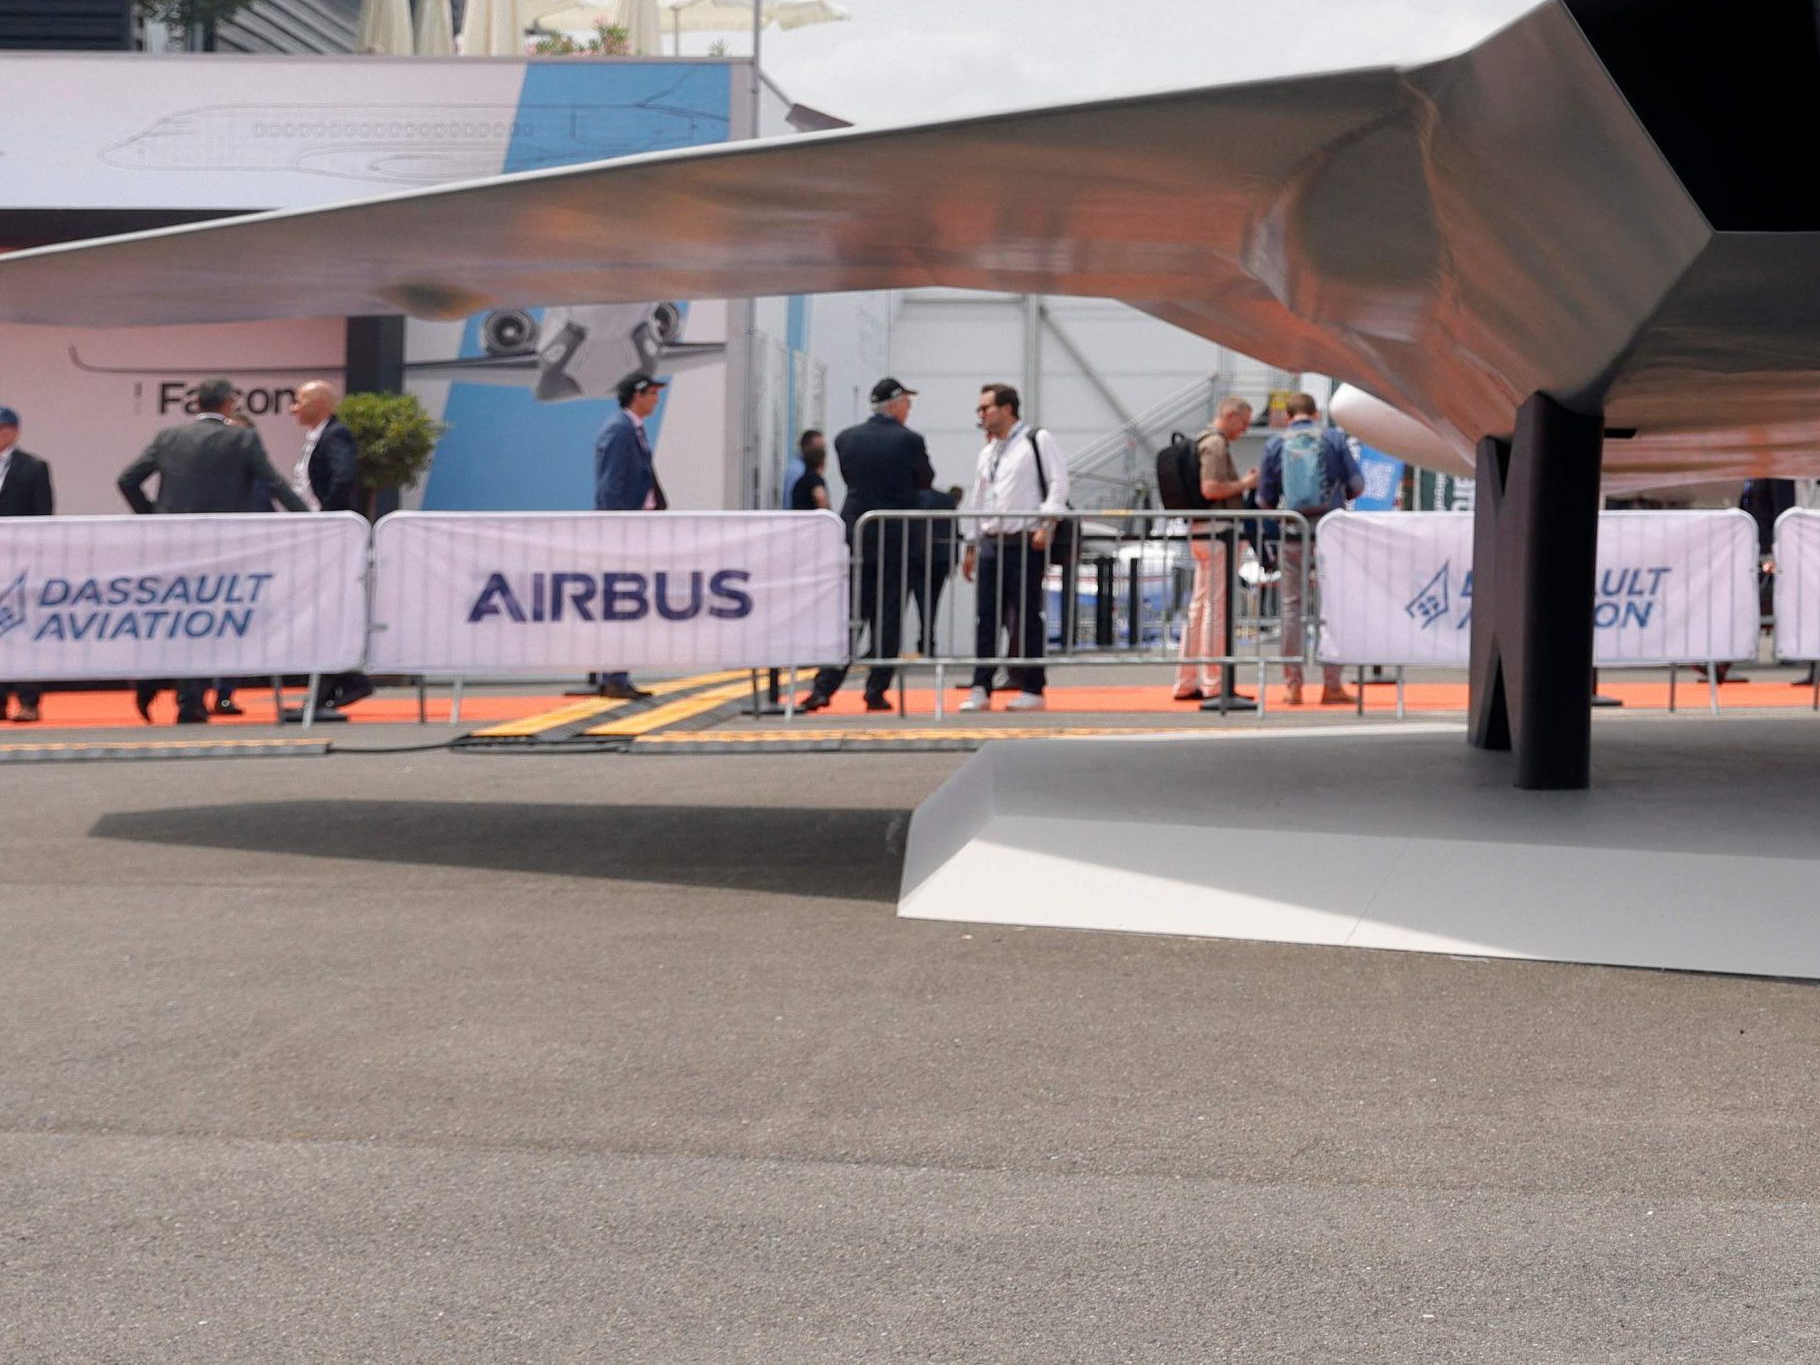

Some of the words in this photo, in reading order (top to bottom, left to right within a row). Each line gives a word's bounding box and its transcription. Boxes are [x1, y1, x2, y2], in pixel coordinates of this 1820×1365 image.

[159, 383, 299, 415] Faon
[38, 574, 274, 606] DASSAULT
[467, 570, 754, 622] AIRBUS
[33, 609, 254, 641] AVIATION
